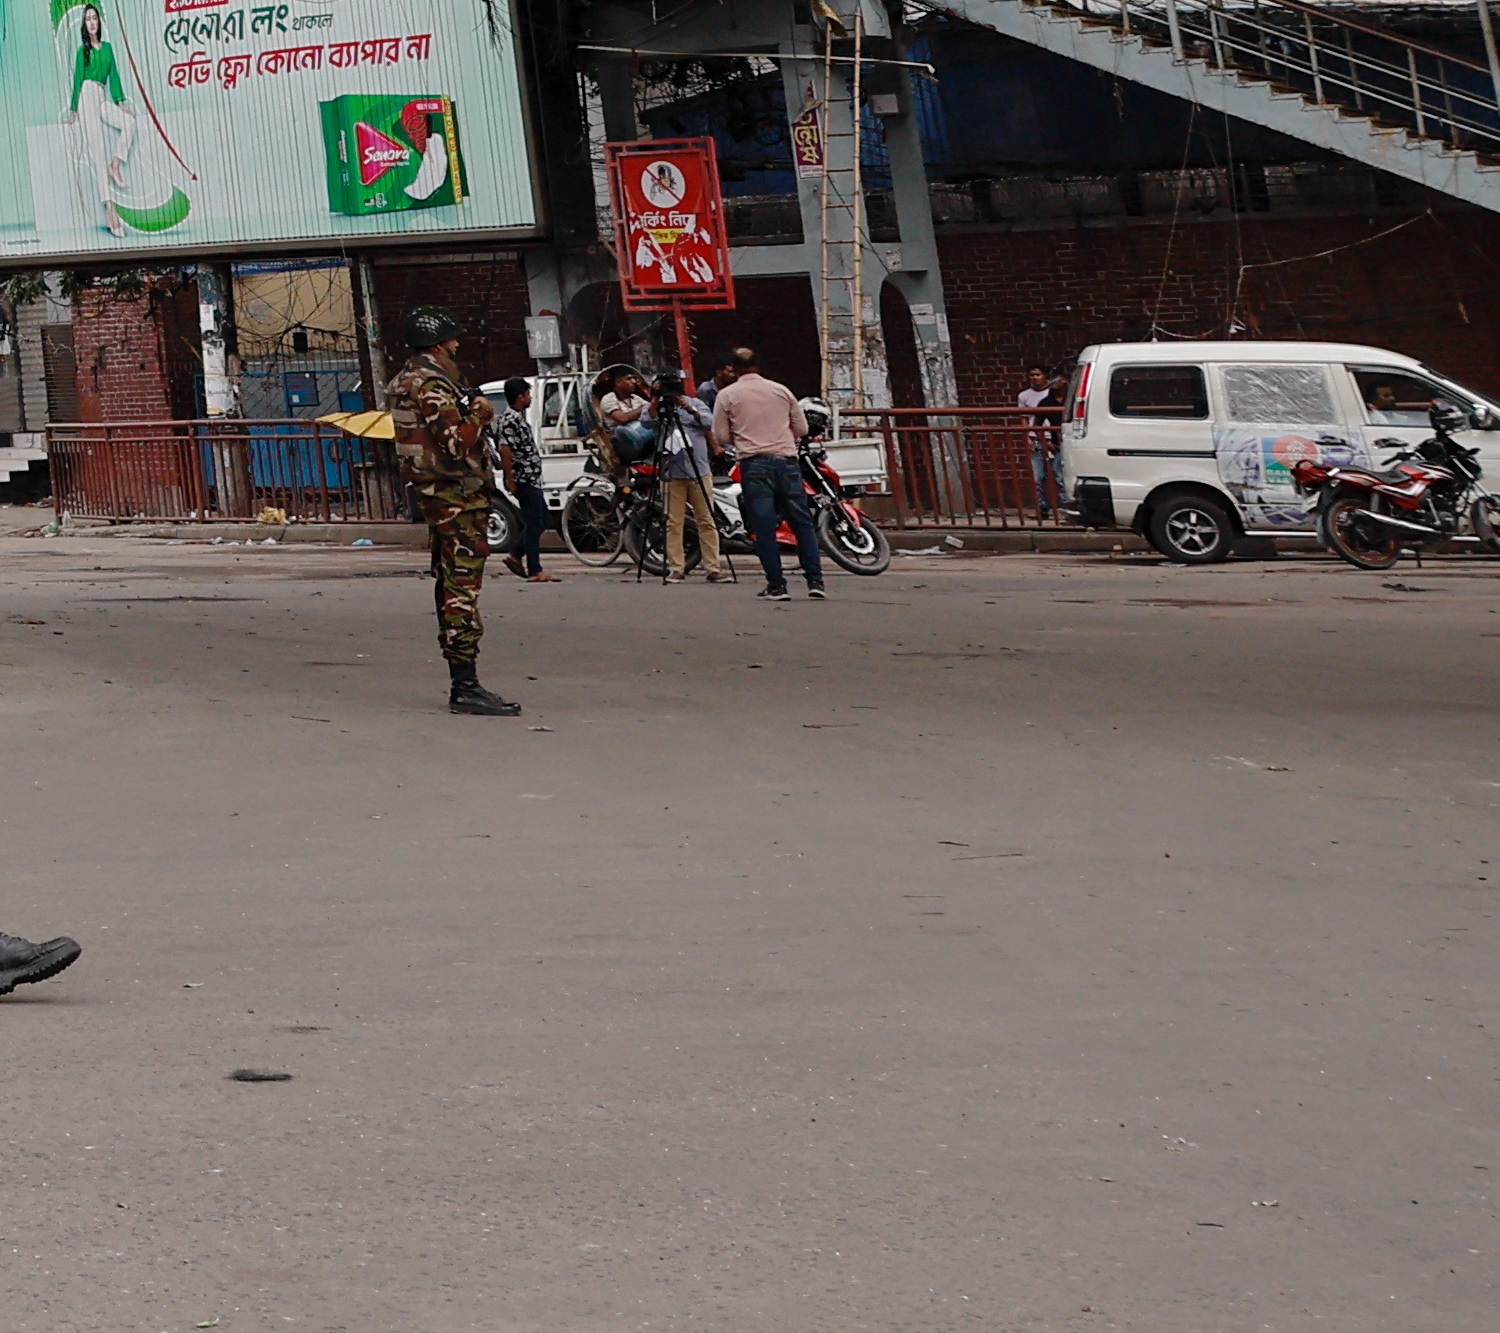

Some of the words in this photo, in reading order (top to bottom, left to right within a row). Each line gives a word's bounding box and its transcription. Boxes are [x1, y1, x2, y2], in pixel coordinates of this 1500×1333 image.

[251, 4, 289, 35] লং
[168, 51, 212, 90] হেভি
[257, 44, 324, 77] কোনো
[328, 37, 401, 68] ব্যাপার
[406, 33, 432, 61] না
